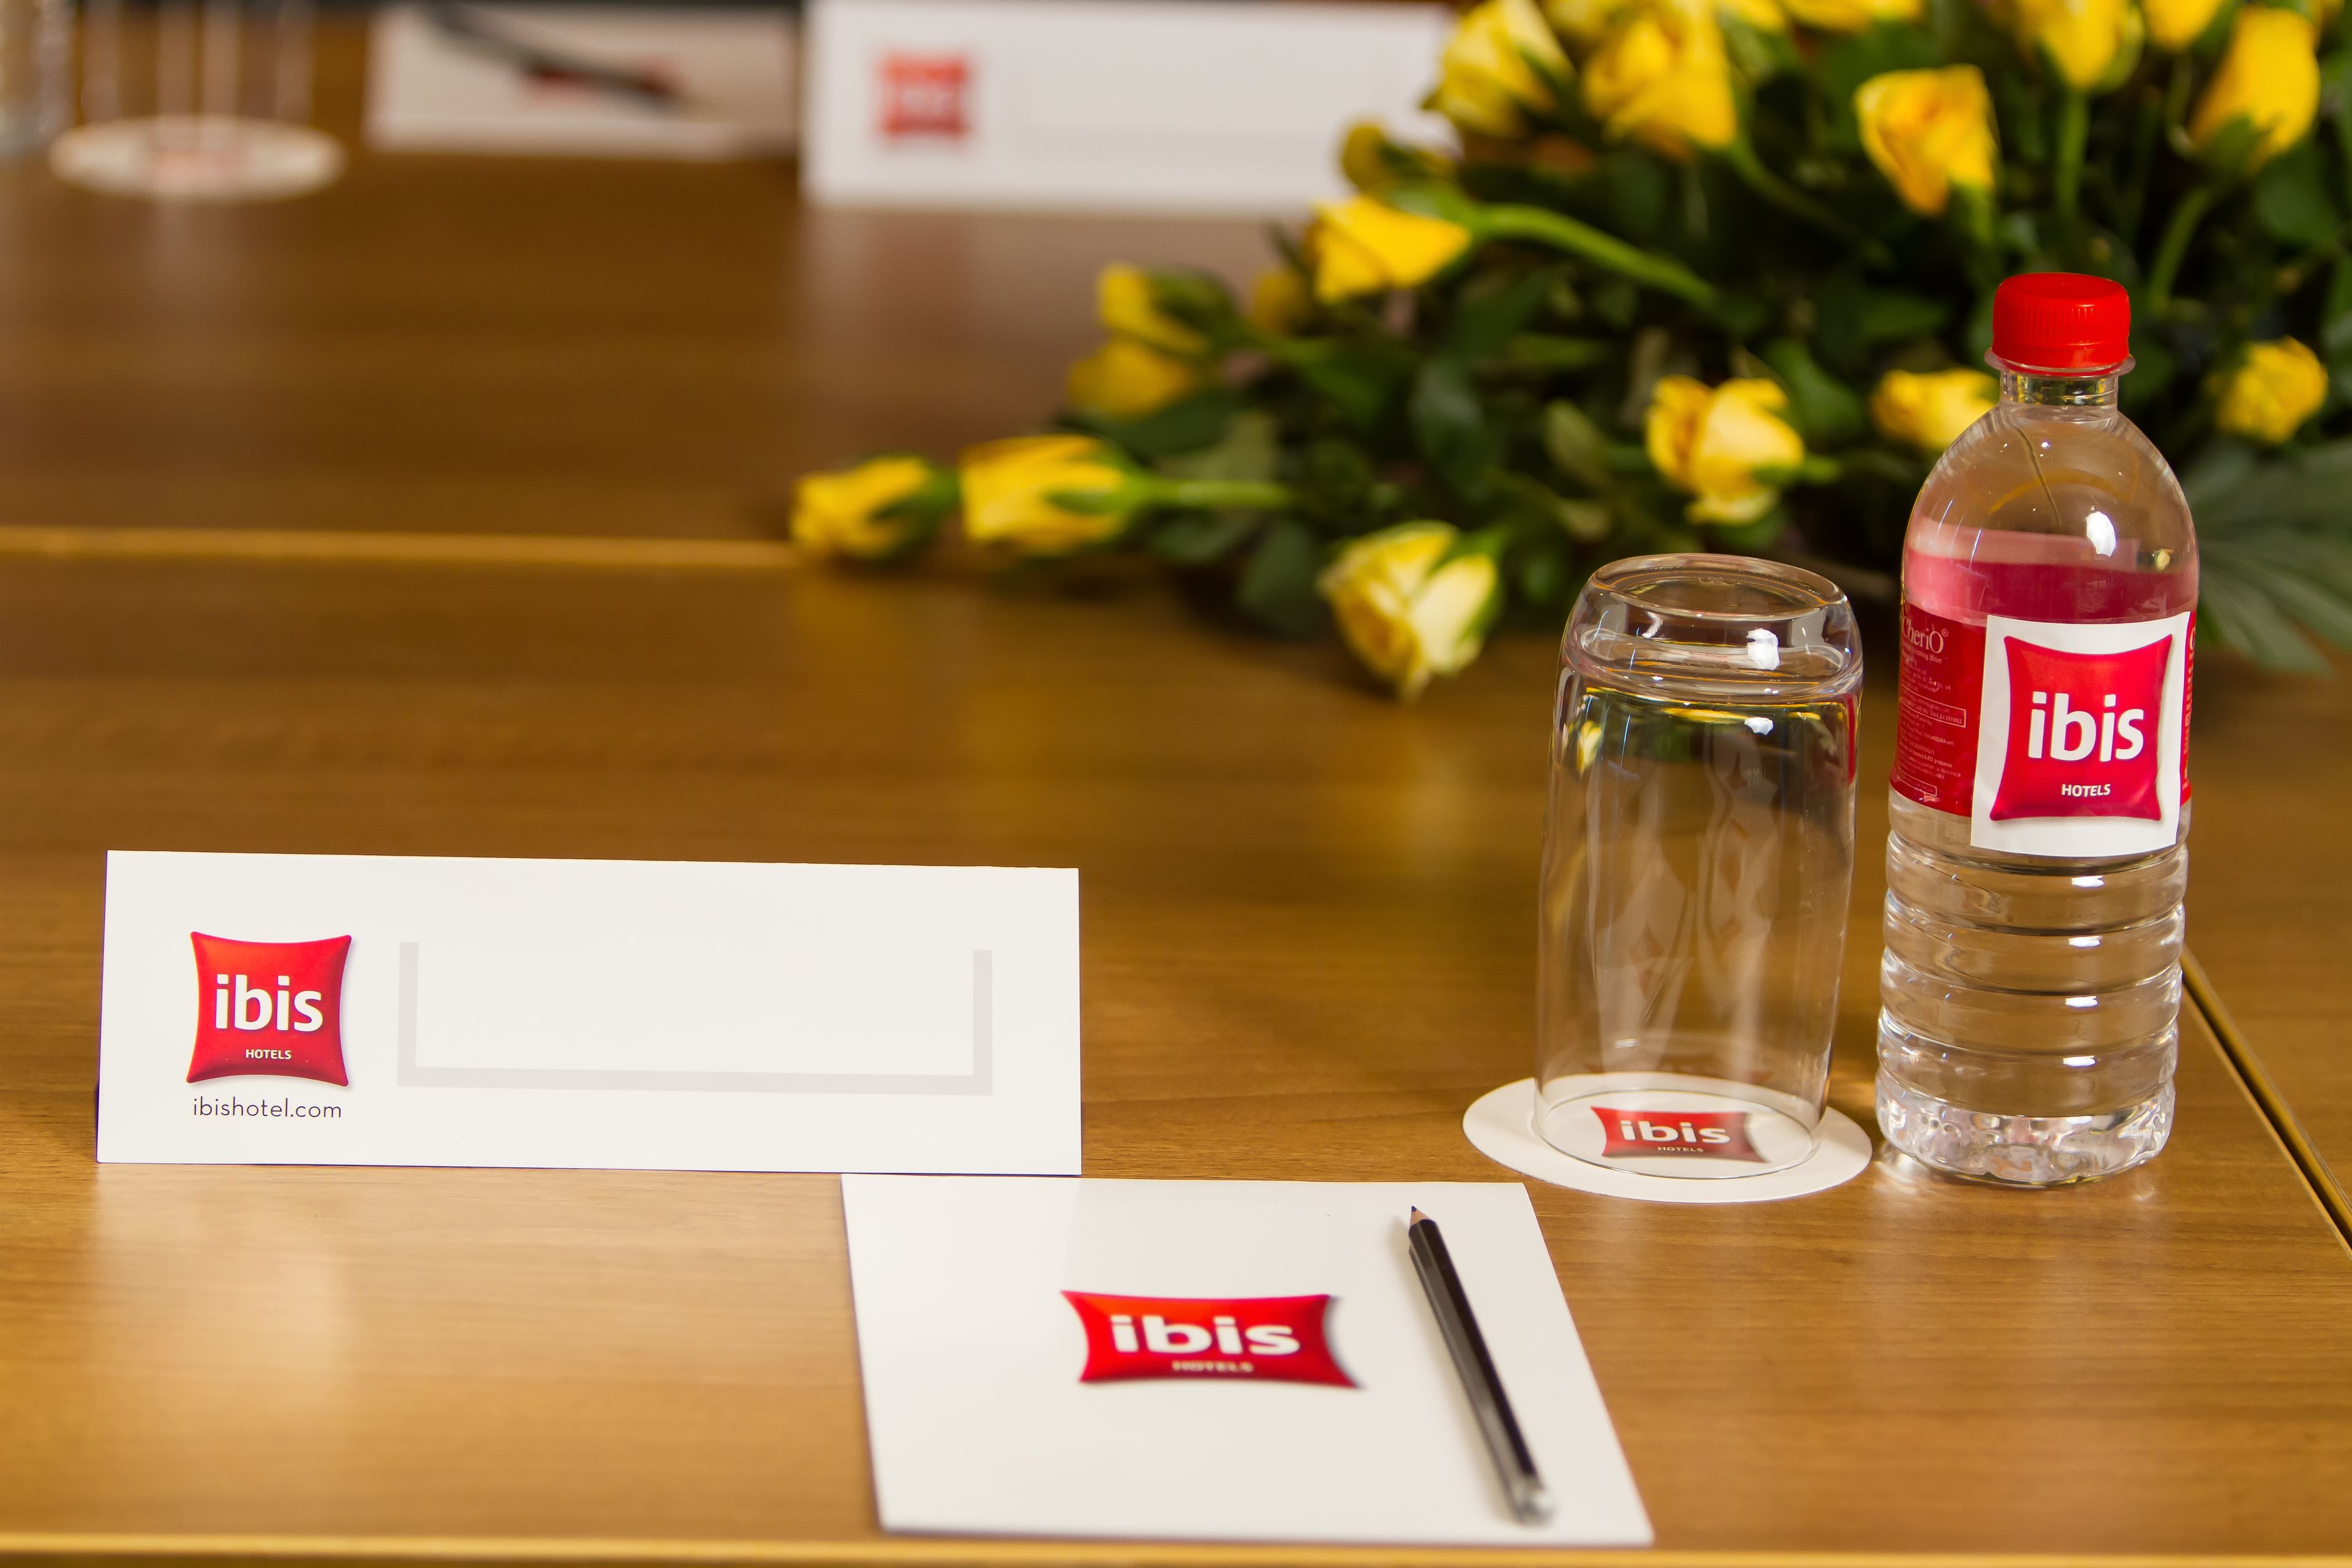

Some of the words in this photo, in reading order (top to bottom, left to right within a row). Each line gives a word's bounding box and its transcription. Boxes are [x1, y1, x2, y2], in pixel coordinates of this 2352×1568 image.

[2028, 691, 2144, 762] ibis
[2061, 783, 2111, 797] HOTELS
[215, 973, 323, 1033] ibis
[246, 1049, 292, 1060] HOTELS
[193, 1096, 342, 1118] ibishotel.com
[1619, 1120, 1731, 1144] ibis
[1110, 1314, 1301, 1356] ibis
[1172, 1360, 1254, 1373] HOTELS
